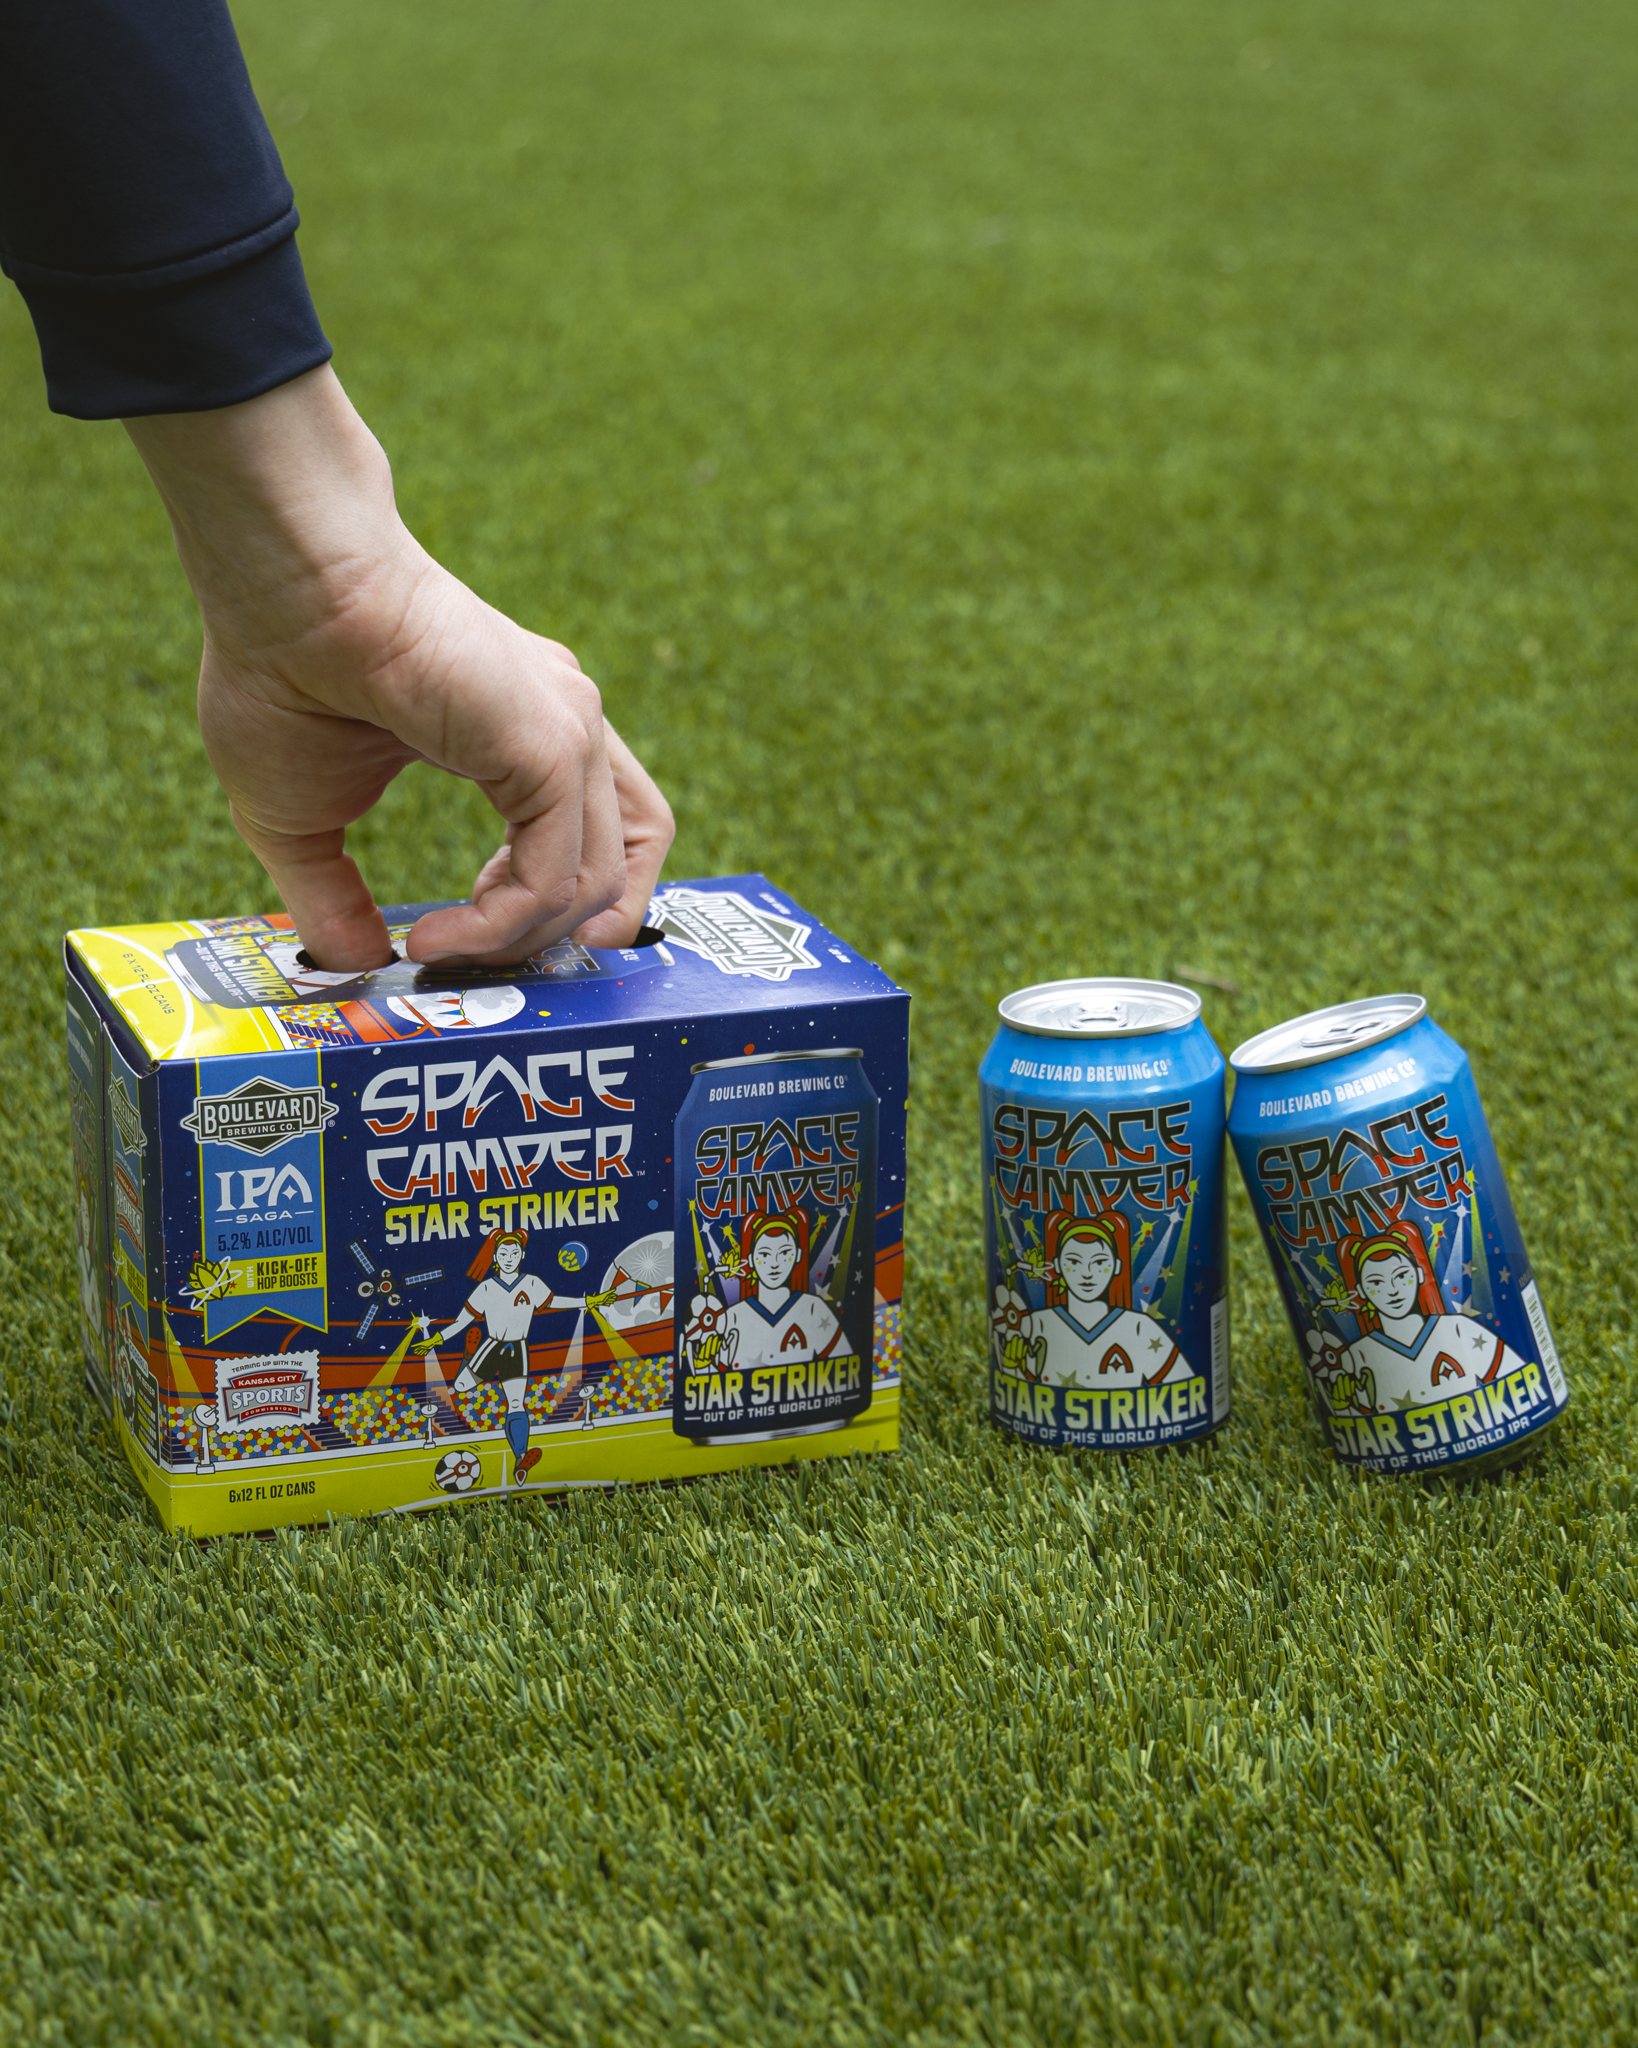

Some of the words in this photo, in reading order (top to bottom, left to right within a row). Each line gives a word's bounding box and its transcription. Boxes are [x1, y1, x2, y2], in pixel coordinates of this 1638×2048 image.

[666, 898, 794, 965] BOULEVARD
[671, 910, 716, 940] BREWING
[208, 936, 262, 960] STAR
[222, 956, 299, 1002] STRIKER
[153, 994, 176, 1015] CANS
[1010, 1058, 1082, 1082] BOULEVARD
[1086, 1063, 1150, 1082] BREWING
[361, 1045, 635, 1136] SPACE
[709, 1082, 774, 1102] BOULEVARD
[779, 1077, 831, 1094] BREWING
[1259, 1089, 1332, 1117] BOULEVARD
[1334, 1067, 1399, 1102] BREWING
[204, 1095, 317, 1135] BOULEVARD
[227, 1124, 277, 1137] BREWING
[279, 1122, 296, 1132] CO.
[695, 1111, 860, 1177] SPACE
[993, 1100, 1192, 1167] SPACE
[1257, 1093, 1460, 1200] SPACE
[366, 1123, 633, 1200] CAMPER
[214, 1163, 313, 1212] IPA
[695, 1163, 858, 1219] CAMPER
[993, 1158, 1193, 1214] CAMPER
[1268, 1150, 1474, 1247] CAMPER
[236, 1210, 293, 1224] SAGA
[385, 1201, 470, 1245] STAR
[479, 1185, 620, 1236] STRIKER
[218, 1231, 251, 1252] 5.2%
[256, 1226, 314, 1248] ALC/VOL
[246, 1265, 254, 1288] WITH
[257, 1256, 318, 1276] KICK-OFF
[257, 1276, 277, 1290] HOP
[280, 1272, 318, 1288] BOOSTS
[231, 1362, 261, 1374] TEAMING
[238, 1377, 275, 1386] KANSAS
[277, 1374, 297, 1383] CITY
[684, 1372, 744, 1411] STAR
[751, 1355, 860, 1405] STRIKER
[231, 1385, 306, 1409] SPORTS
[245, 1406, 293, 1416] COMMISSION
[703, 1411, 725, 1423] OUT
[728, 1409, 744, 1420] OF
[747, 1405, 775, 1418] THIS
[779, 1399, 821, 1414] WORLD
[824, 1395, 842, 1408] IPA
[994, 1369, 1057, 1427] STAR
[1065, 1376, 1207, 1430] STRIKER
[1328, 1414, 1405, 1456] STAR
[1405, 1362, 1548, 1450] STRIKER
[1013, 1421, 1036, 1436] OUT
[1039, 1426, 1058, 1439] OF
[1062, 1430, 1096, 1444] THIS
[1102, 1429, 1155, 1444] WORLD
[1160, 1424, 1182, 1439] IPA
[1361, 1458, 1386, 1470] OUT
[1390, 1456, 1409, 1467] OF
[1412, 1447, 1449, 1464] THIS
[1452, 1428, 1505, 1454] WORLD
[1508, 1416, 1531, 1435] IPA
[256, 1484, 267, 1499] FL
[270, 1483, 283, 1497] OZ
[286, 1481, 316, 1496] CANS
